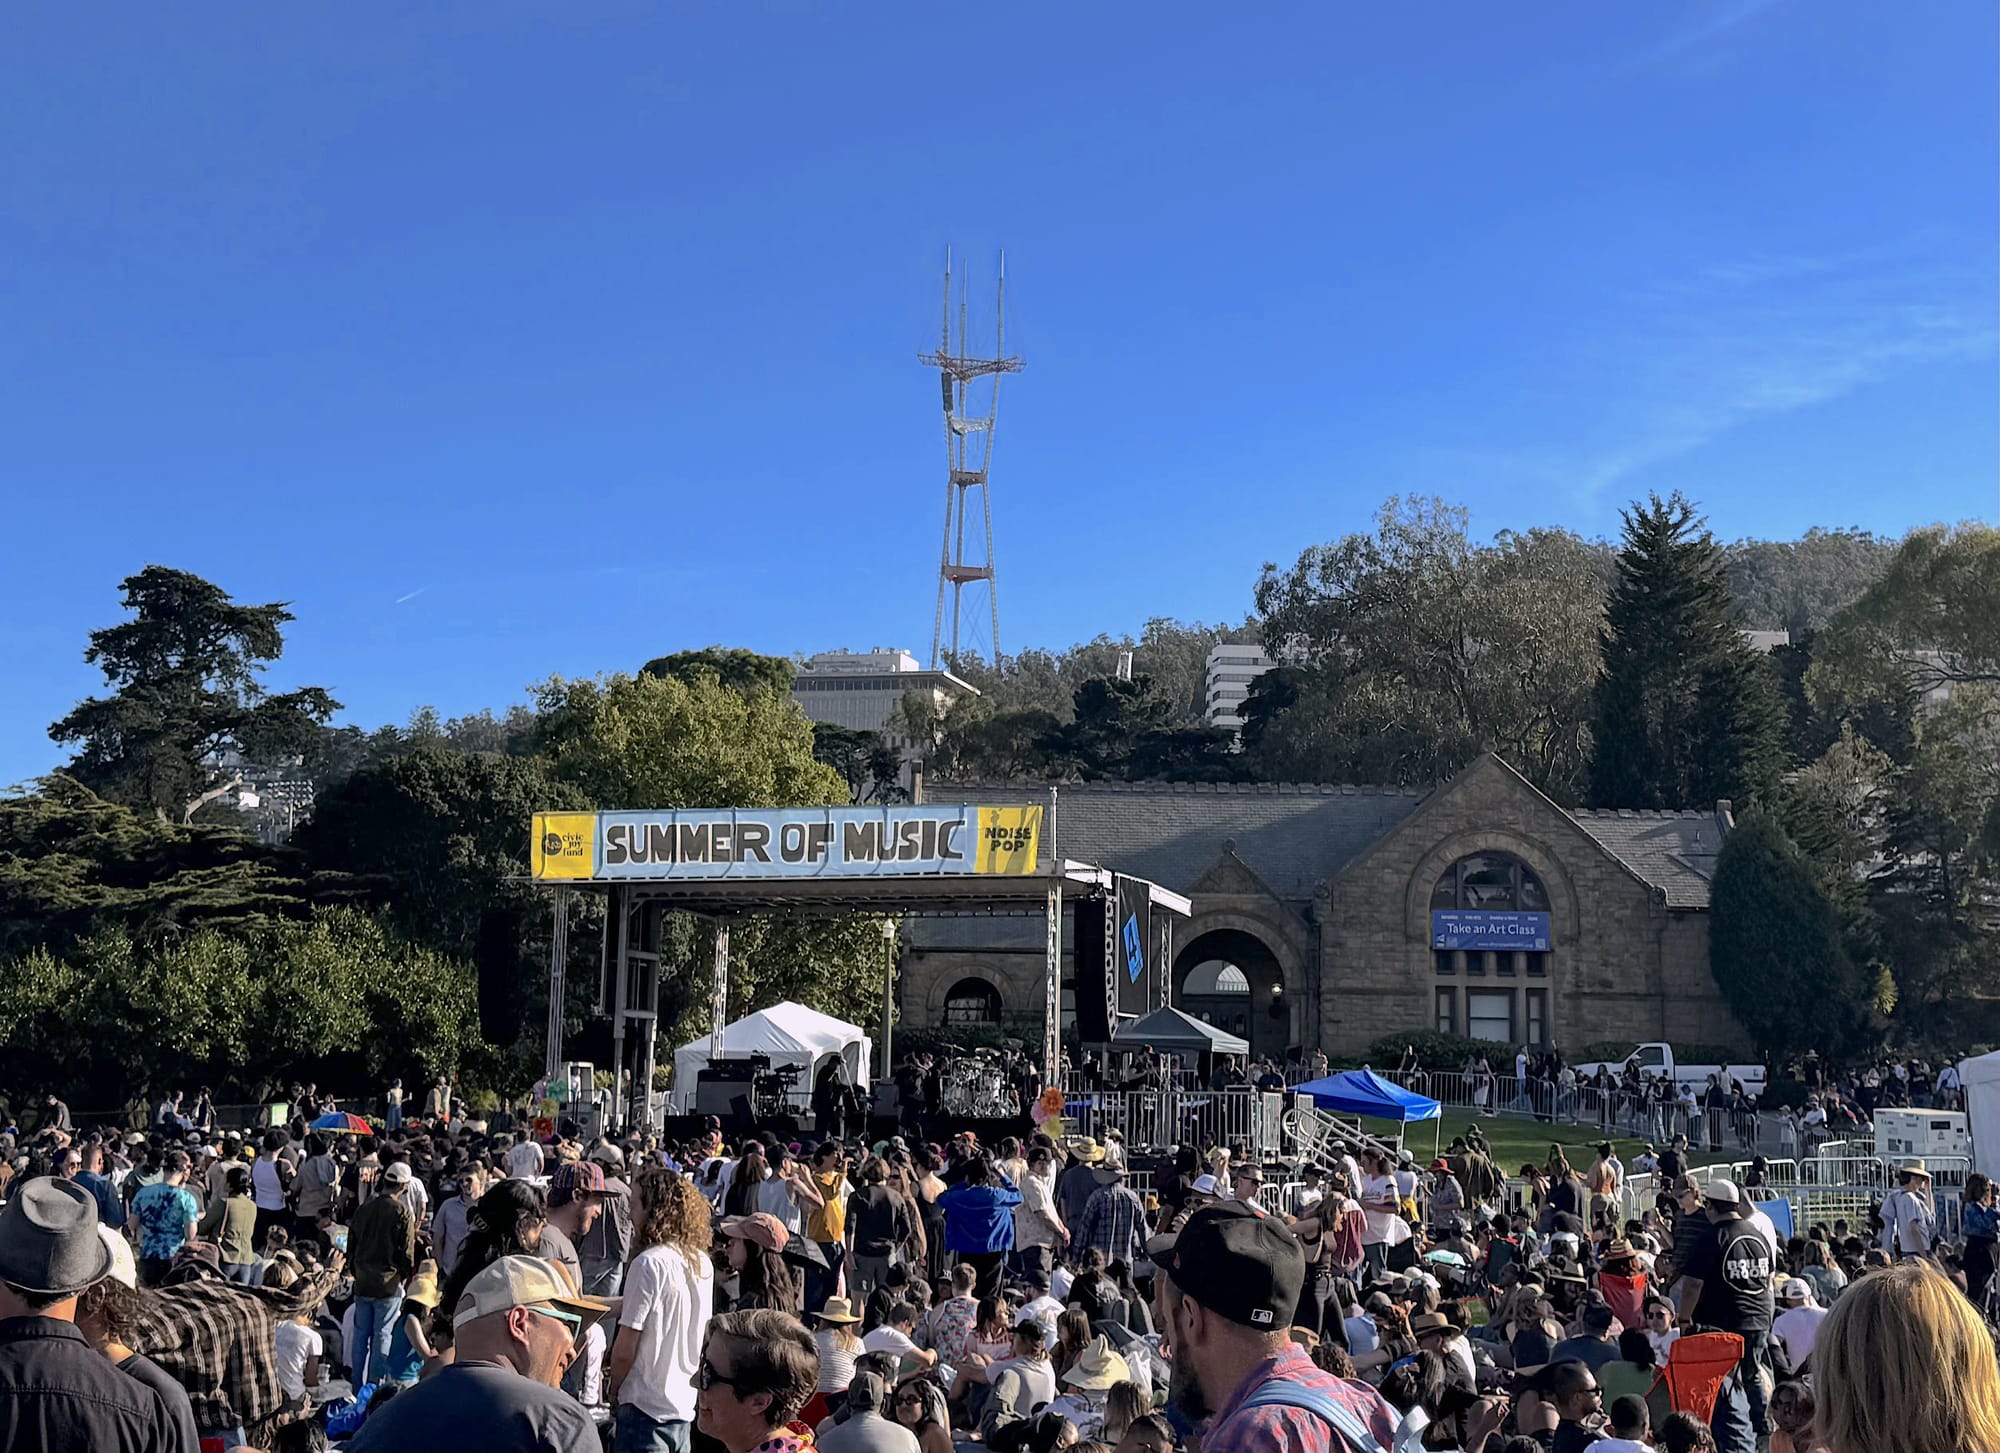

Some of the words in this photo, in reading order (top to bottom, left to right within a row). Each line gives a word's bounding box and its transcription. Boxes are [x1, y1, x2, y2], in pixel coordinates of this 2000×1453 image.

[562, 832, 584, 842] civic
[985, 827, 1032, 840] NOISE
[606, 822, 772, 865] SUMMER
[780, 820, 836, 864] OF
[843, 818, 966, 864] MUSIC
[990, 840, 1025, 852] POP
[563, 848, 583, 857] fund
[1447, 923, 1471, 934] Take
[1473, 926, 1486, 934] an
[1488, 923, 1506, 935] Art
[1508, 924, 1536, 935] Class
